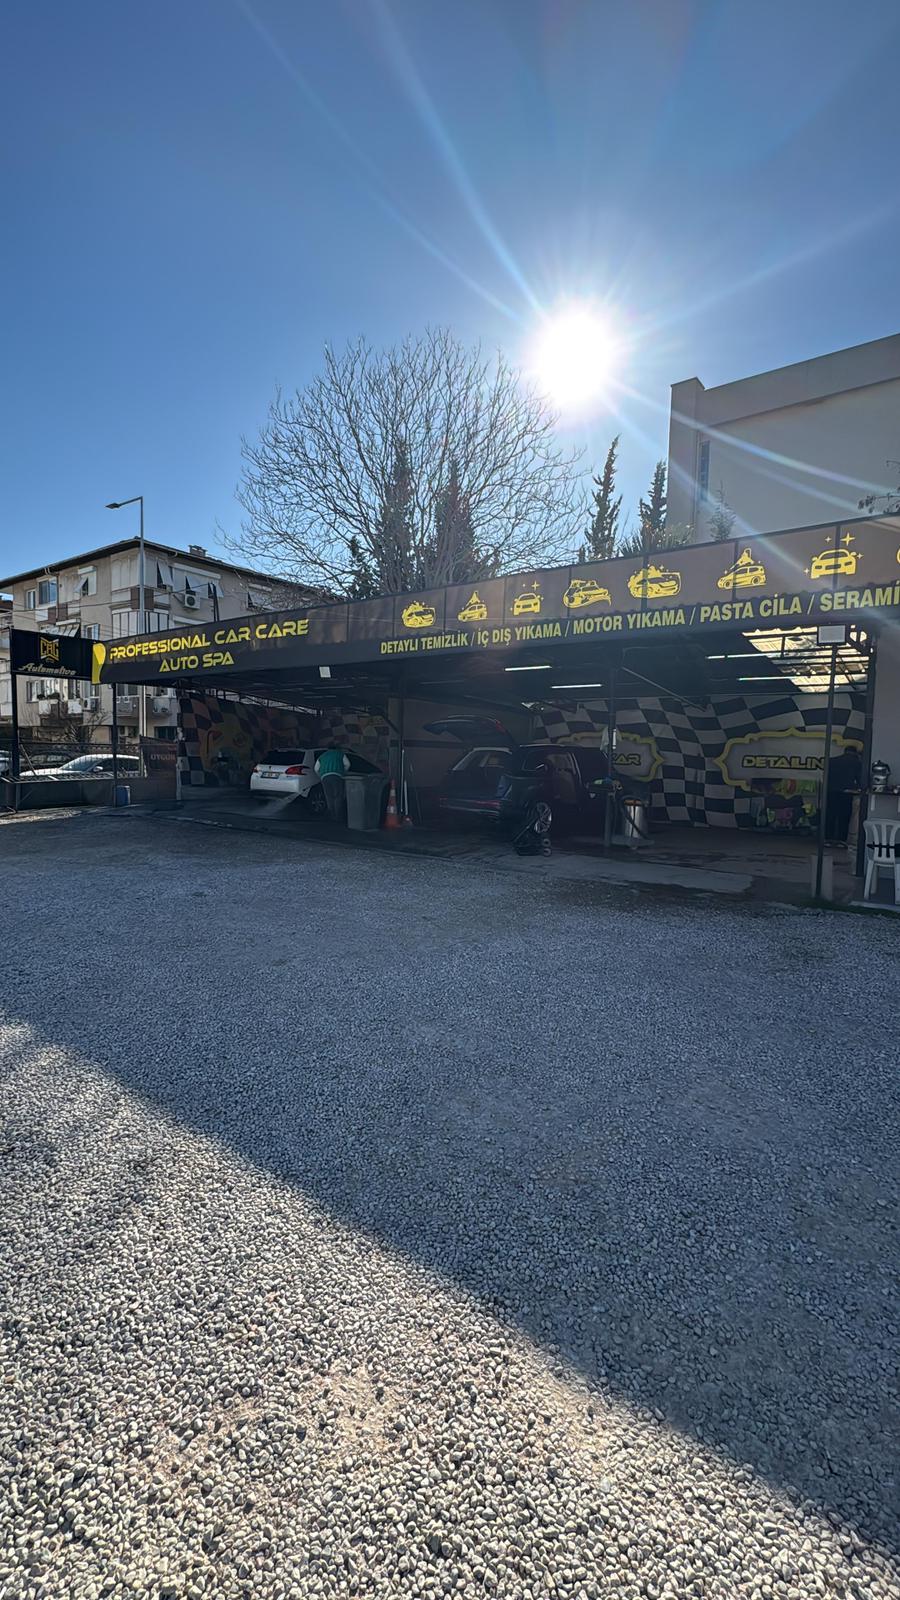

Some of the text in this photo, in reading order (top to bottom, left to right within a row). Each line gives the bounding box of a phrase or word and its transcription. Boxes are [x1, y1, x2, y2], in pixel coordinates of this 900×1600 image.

[110, 618, 309, 660] PROFESSIONAL CAR CARE
[380, 638, 418, 654] DETAYLI
[421, 629, 468, 650] TEMİZLİK
[477, 628, 489, 648] İÇ
[492, 627, 511, 646] DIŞ
[515, 622, 562, 641] YIKAMA
[573, 615, 623, 635] MOTOR
[627, 608, 686, 630] YIKAMA
[700, 601, 754, 622] PASTA
[759, 593, 802, 618] CİLA
[18, 662, 77, 676] Automotive
[159, 651, 235, 672] AUTO SPA
